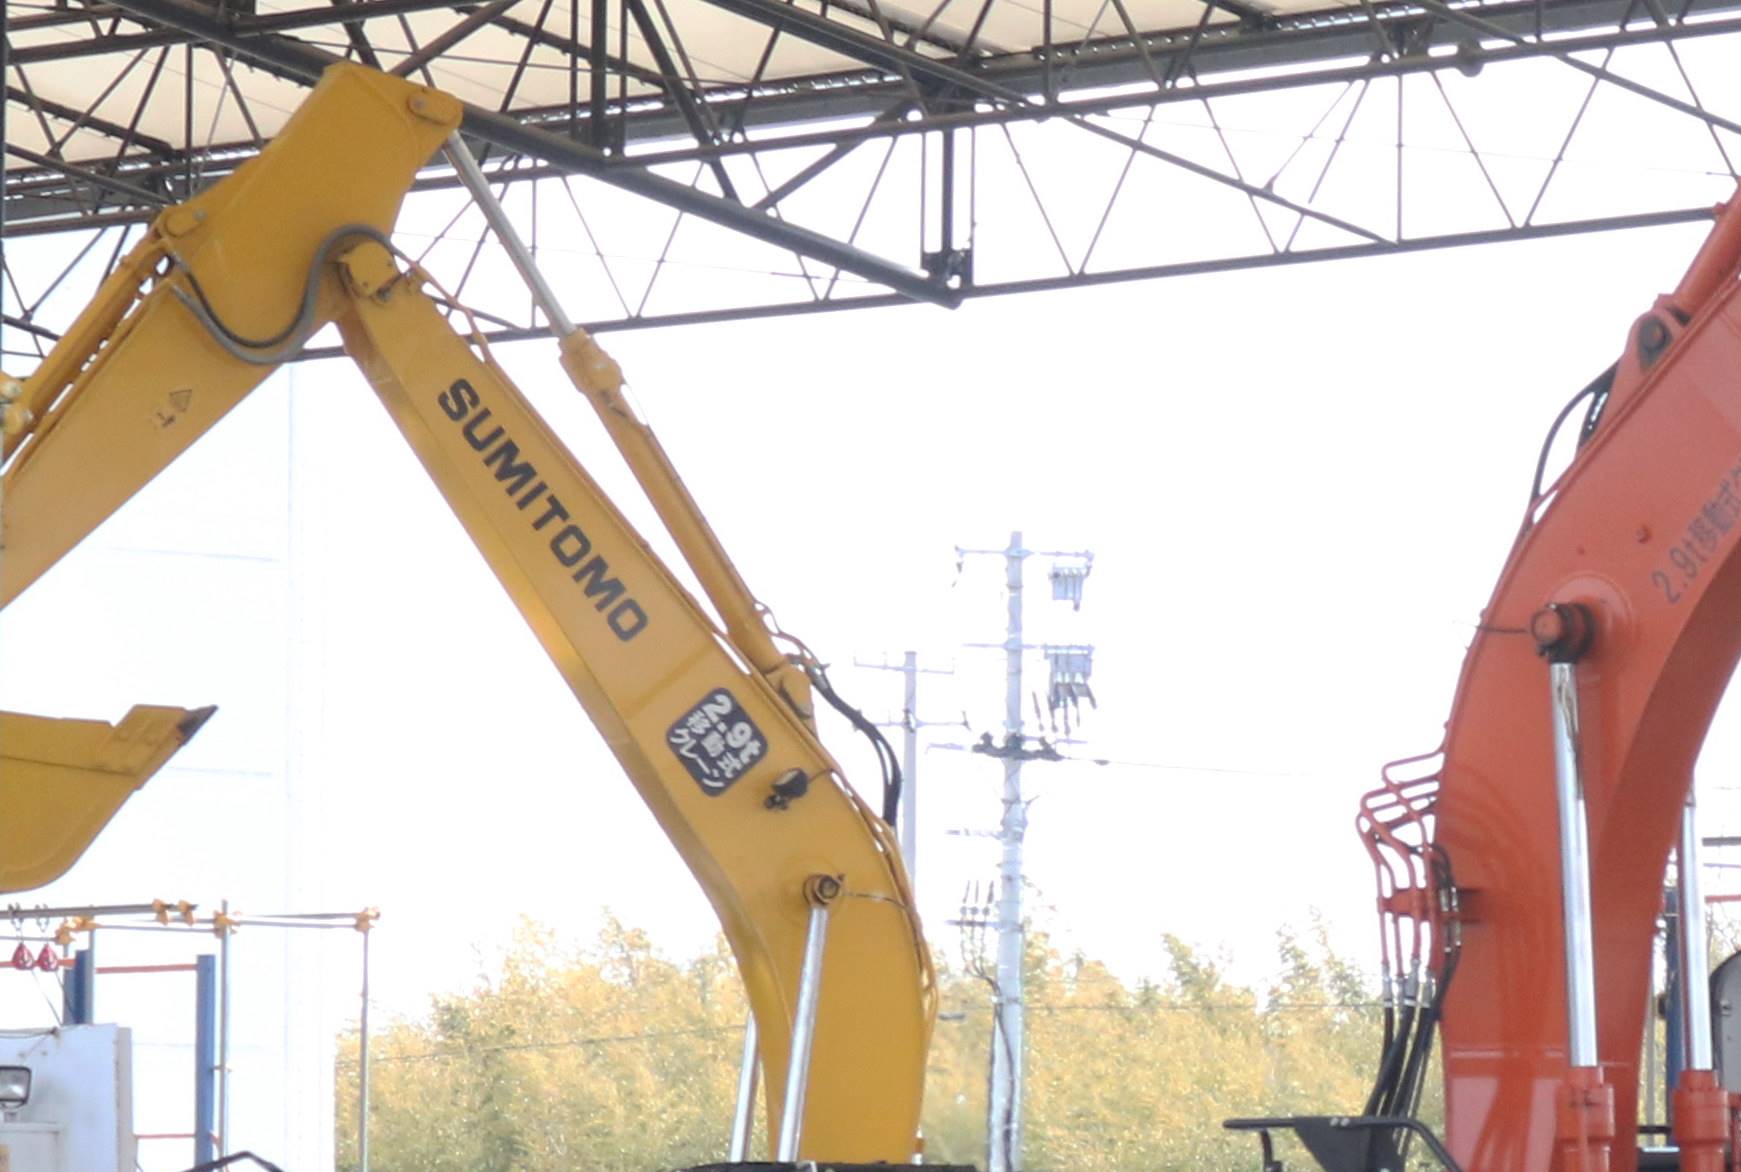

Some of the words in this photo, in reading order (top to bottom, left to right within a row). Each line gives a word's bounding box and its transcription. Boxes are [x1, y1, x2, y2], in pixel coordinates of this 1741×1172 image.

[437, 378, 649, 642] SUMITOMO
[669, 728, 726, 788] クレーン
[686, 709, 743, 779] 移動式
[702, 693, 761, 765] 2.9t
